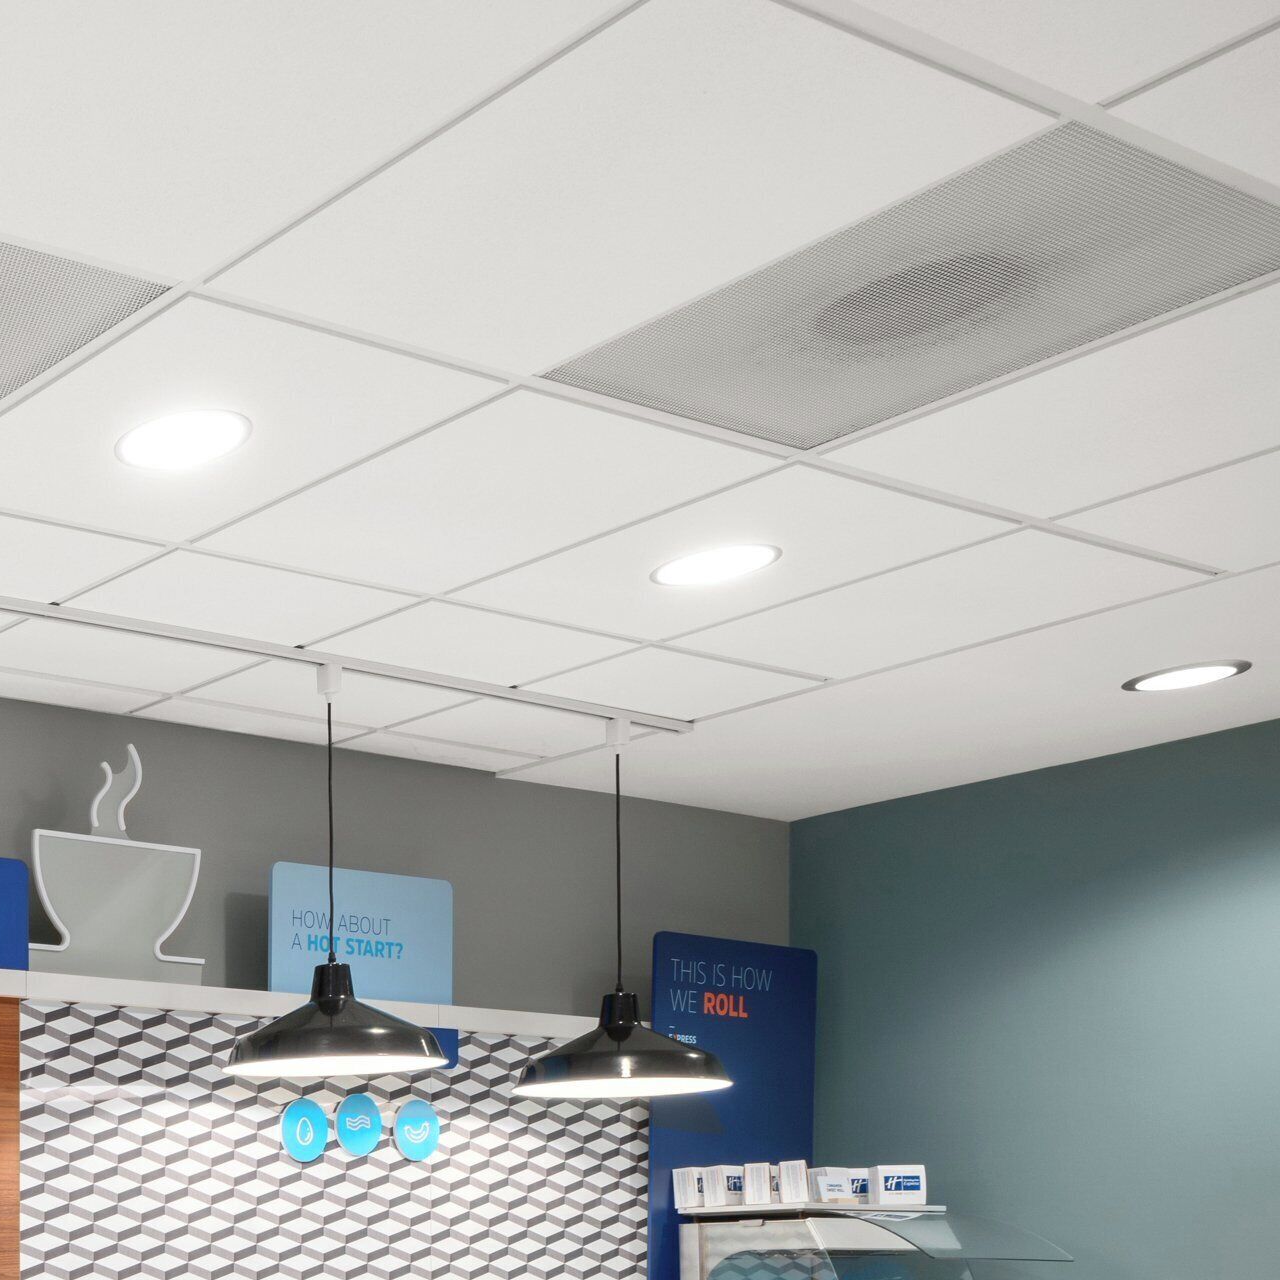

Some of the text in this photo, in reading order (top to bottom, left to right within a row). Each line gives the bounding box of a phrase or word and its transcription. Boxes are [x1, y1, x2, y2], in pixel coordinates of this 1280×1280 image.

[292, 909, 391, 936] HOW ABOUT
[291, 933, 403, 959] A HOT START?
[671, 958, 773, 991] THIS IS HOW
[670, 989, 749, 1018] WE ROLL
